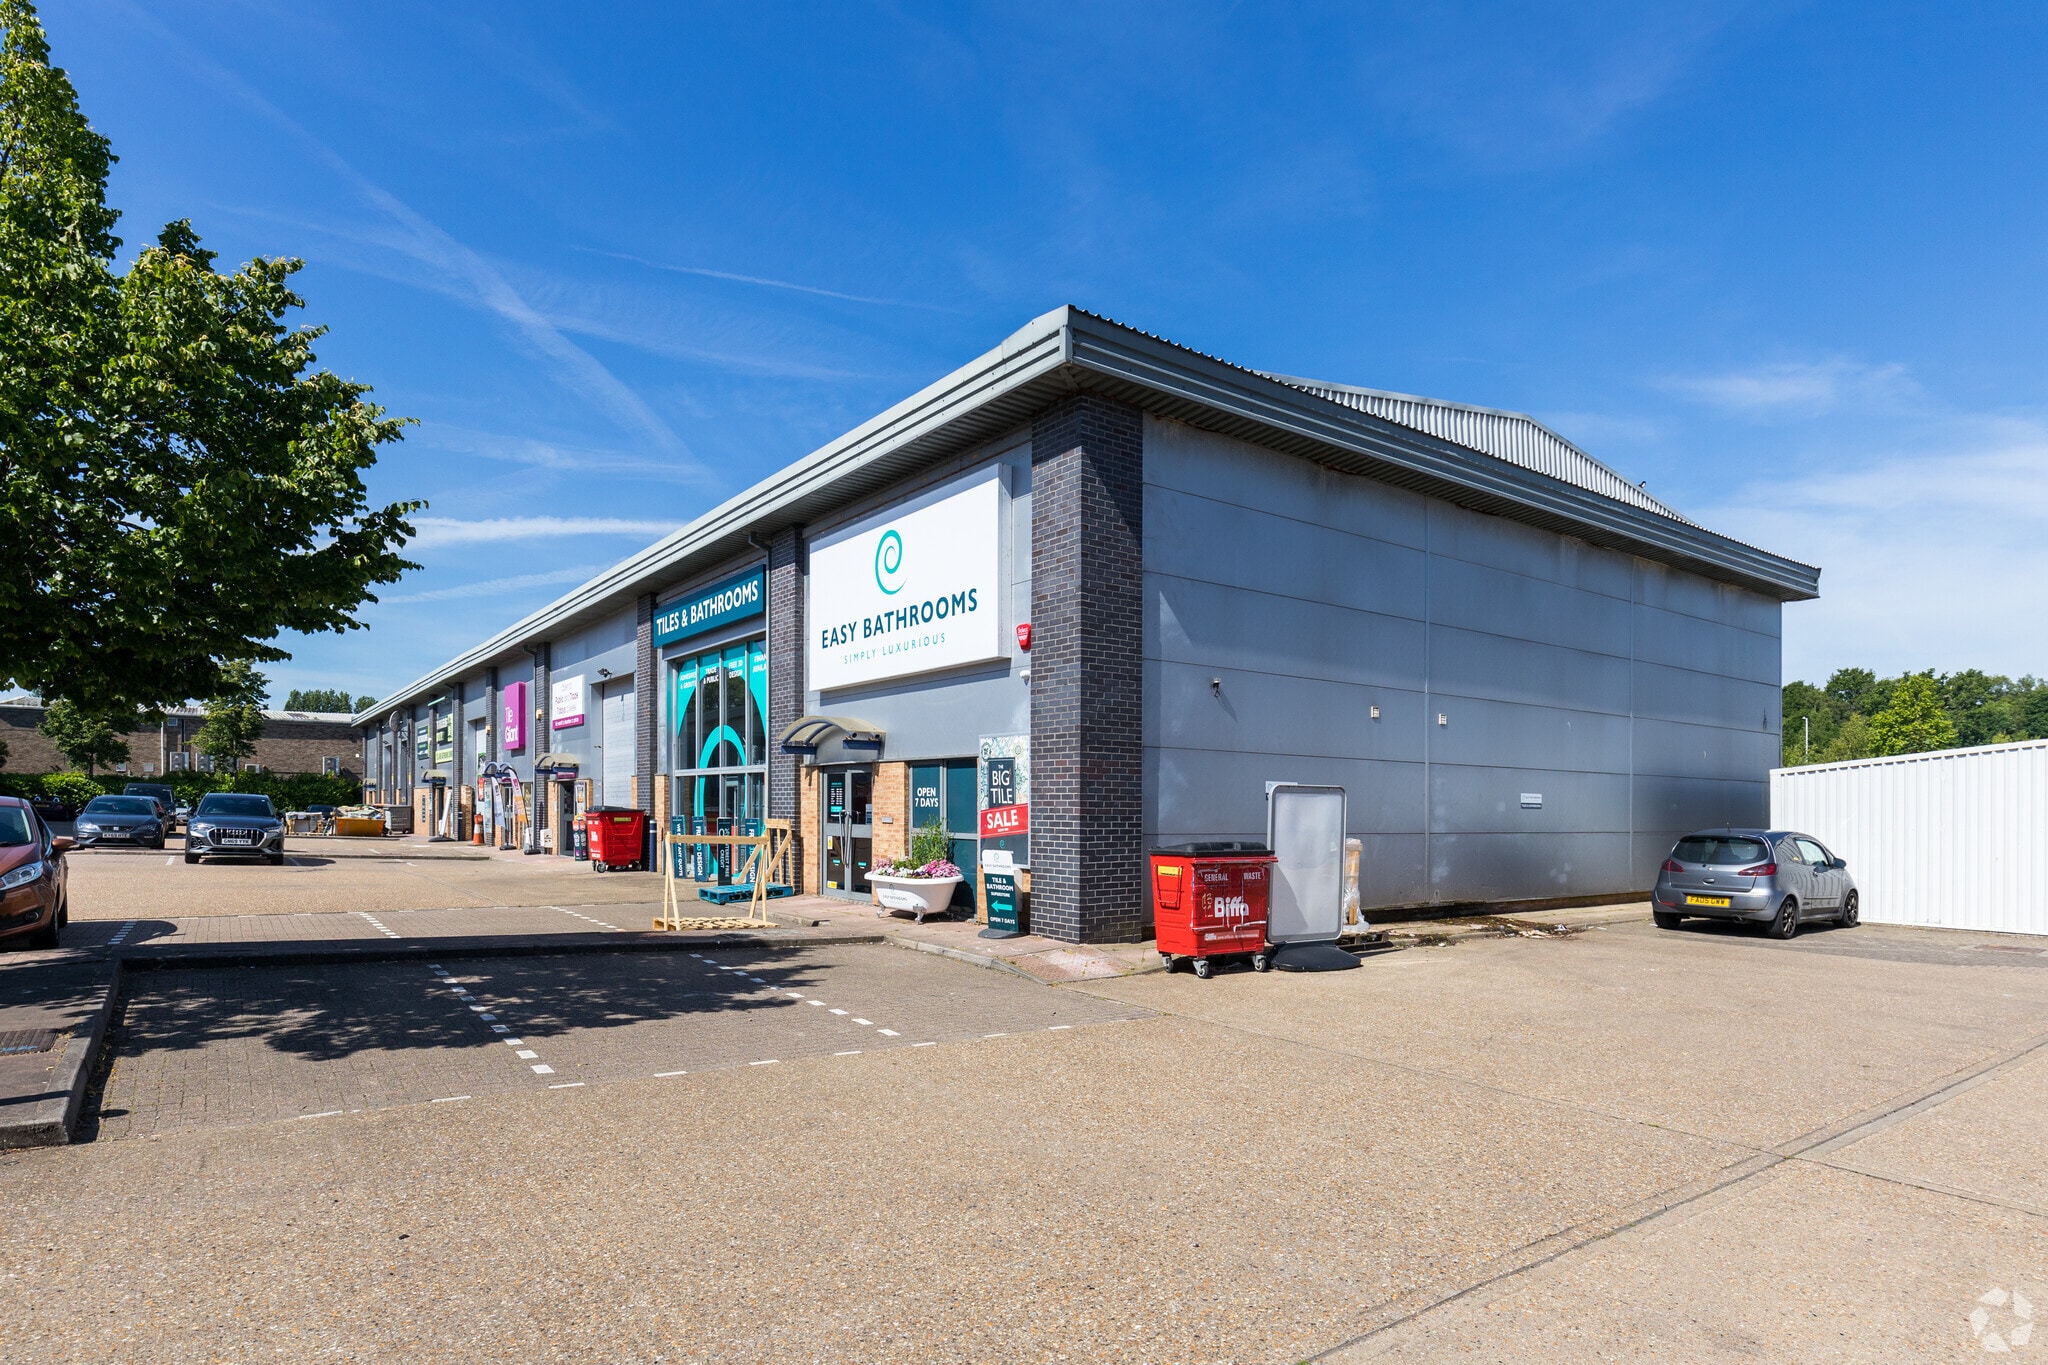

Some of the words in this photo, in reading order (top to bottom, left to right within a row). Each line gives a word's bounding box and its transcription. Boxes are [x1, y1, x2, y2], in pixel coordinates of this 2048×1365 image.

[656, 612, 679, 636] TILES
[681, 608, 688, 628] &
[690, 580, 758, 624] BATHROOMS
[822, 621, 856, 649] EASY
[864, 588, 978, 638] BATHROOMS
[844, 649, 876, 664] SIMPLY
[882, 632, 946, 656] LUXURIOUS
[992, 770, 1010, 786] BIG
[917, 787, 936, 797] OPEN
[990, 788, 1013, 804] TILE
[915, 798, 919, 807] 7
[920, 798, 938, 807] DAYS
[987, 810, 1019, 829] SALE
[1204, 873, 1228, 882] GENERAL
[1244, 872, 1261, 880] WASTE
[1215, 896, 1249, 918] Biffa
